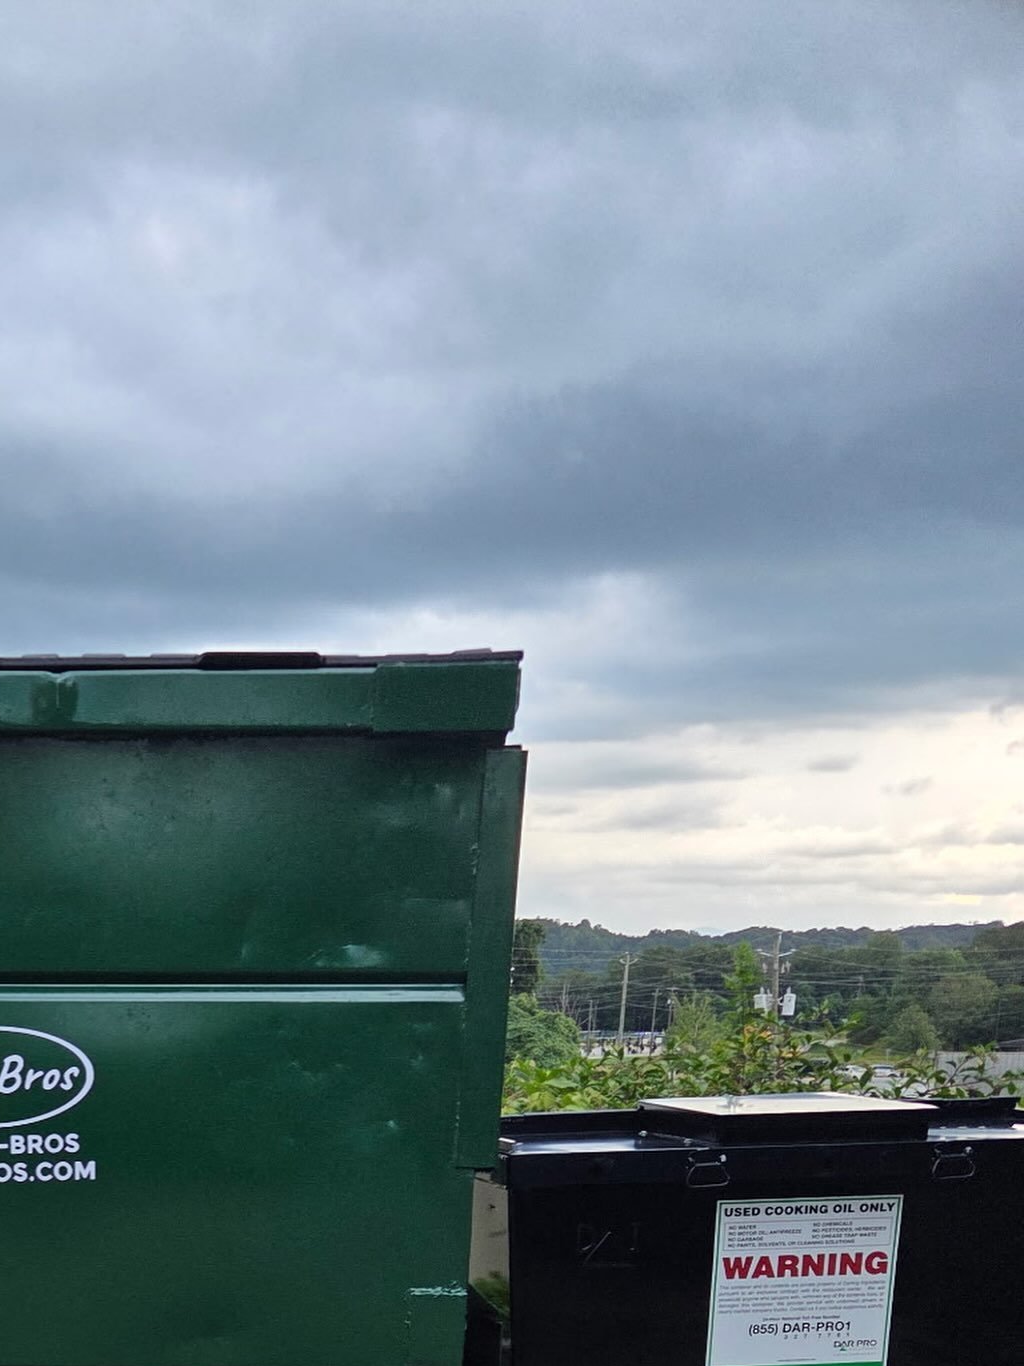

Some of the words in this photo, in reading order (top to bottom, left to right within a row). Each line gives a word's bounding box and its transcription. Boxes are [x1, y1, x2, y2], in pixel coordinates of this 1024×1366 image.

[724, 1206, 761, 1217] USED
[765, 1204, 828, 1216] COOKING
[833, 1203, 855, 1213] OIL
[859, 1202, 896, 1213] ONLY
[723, 1251, 888, 1279] WARNING
[748, 1322, 779, 1337] (855)
[782, 1321, 851, 1334] DAR-PRO1
[833, 1340, 854, 1348] DAR
[857, 1339, 878, 1347] PRO
